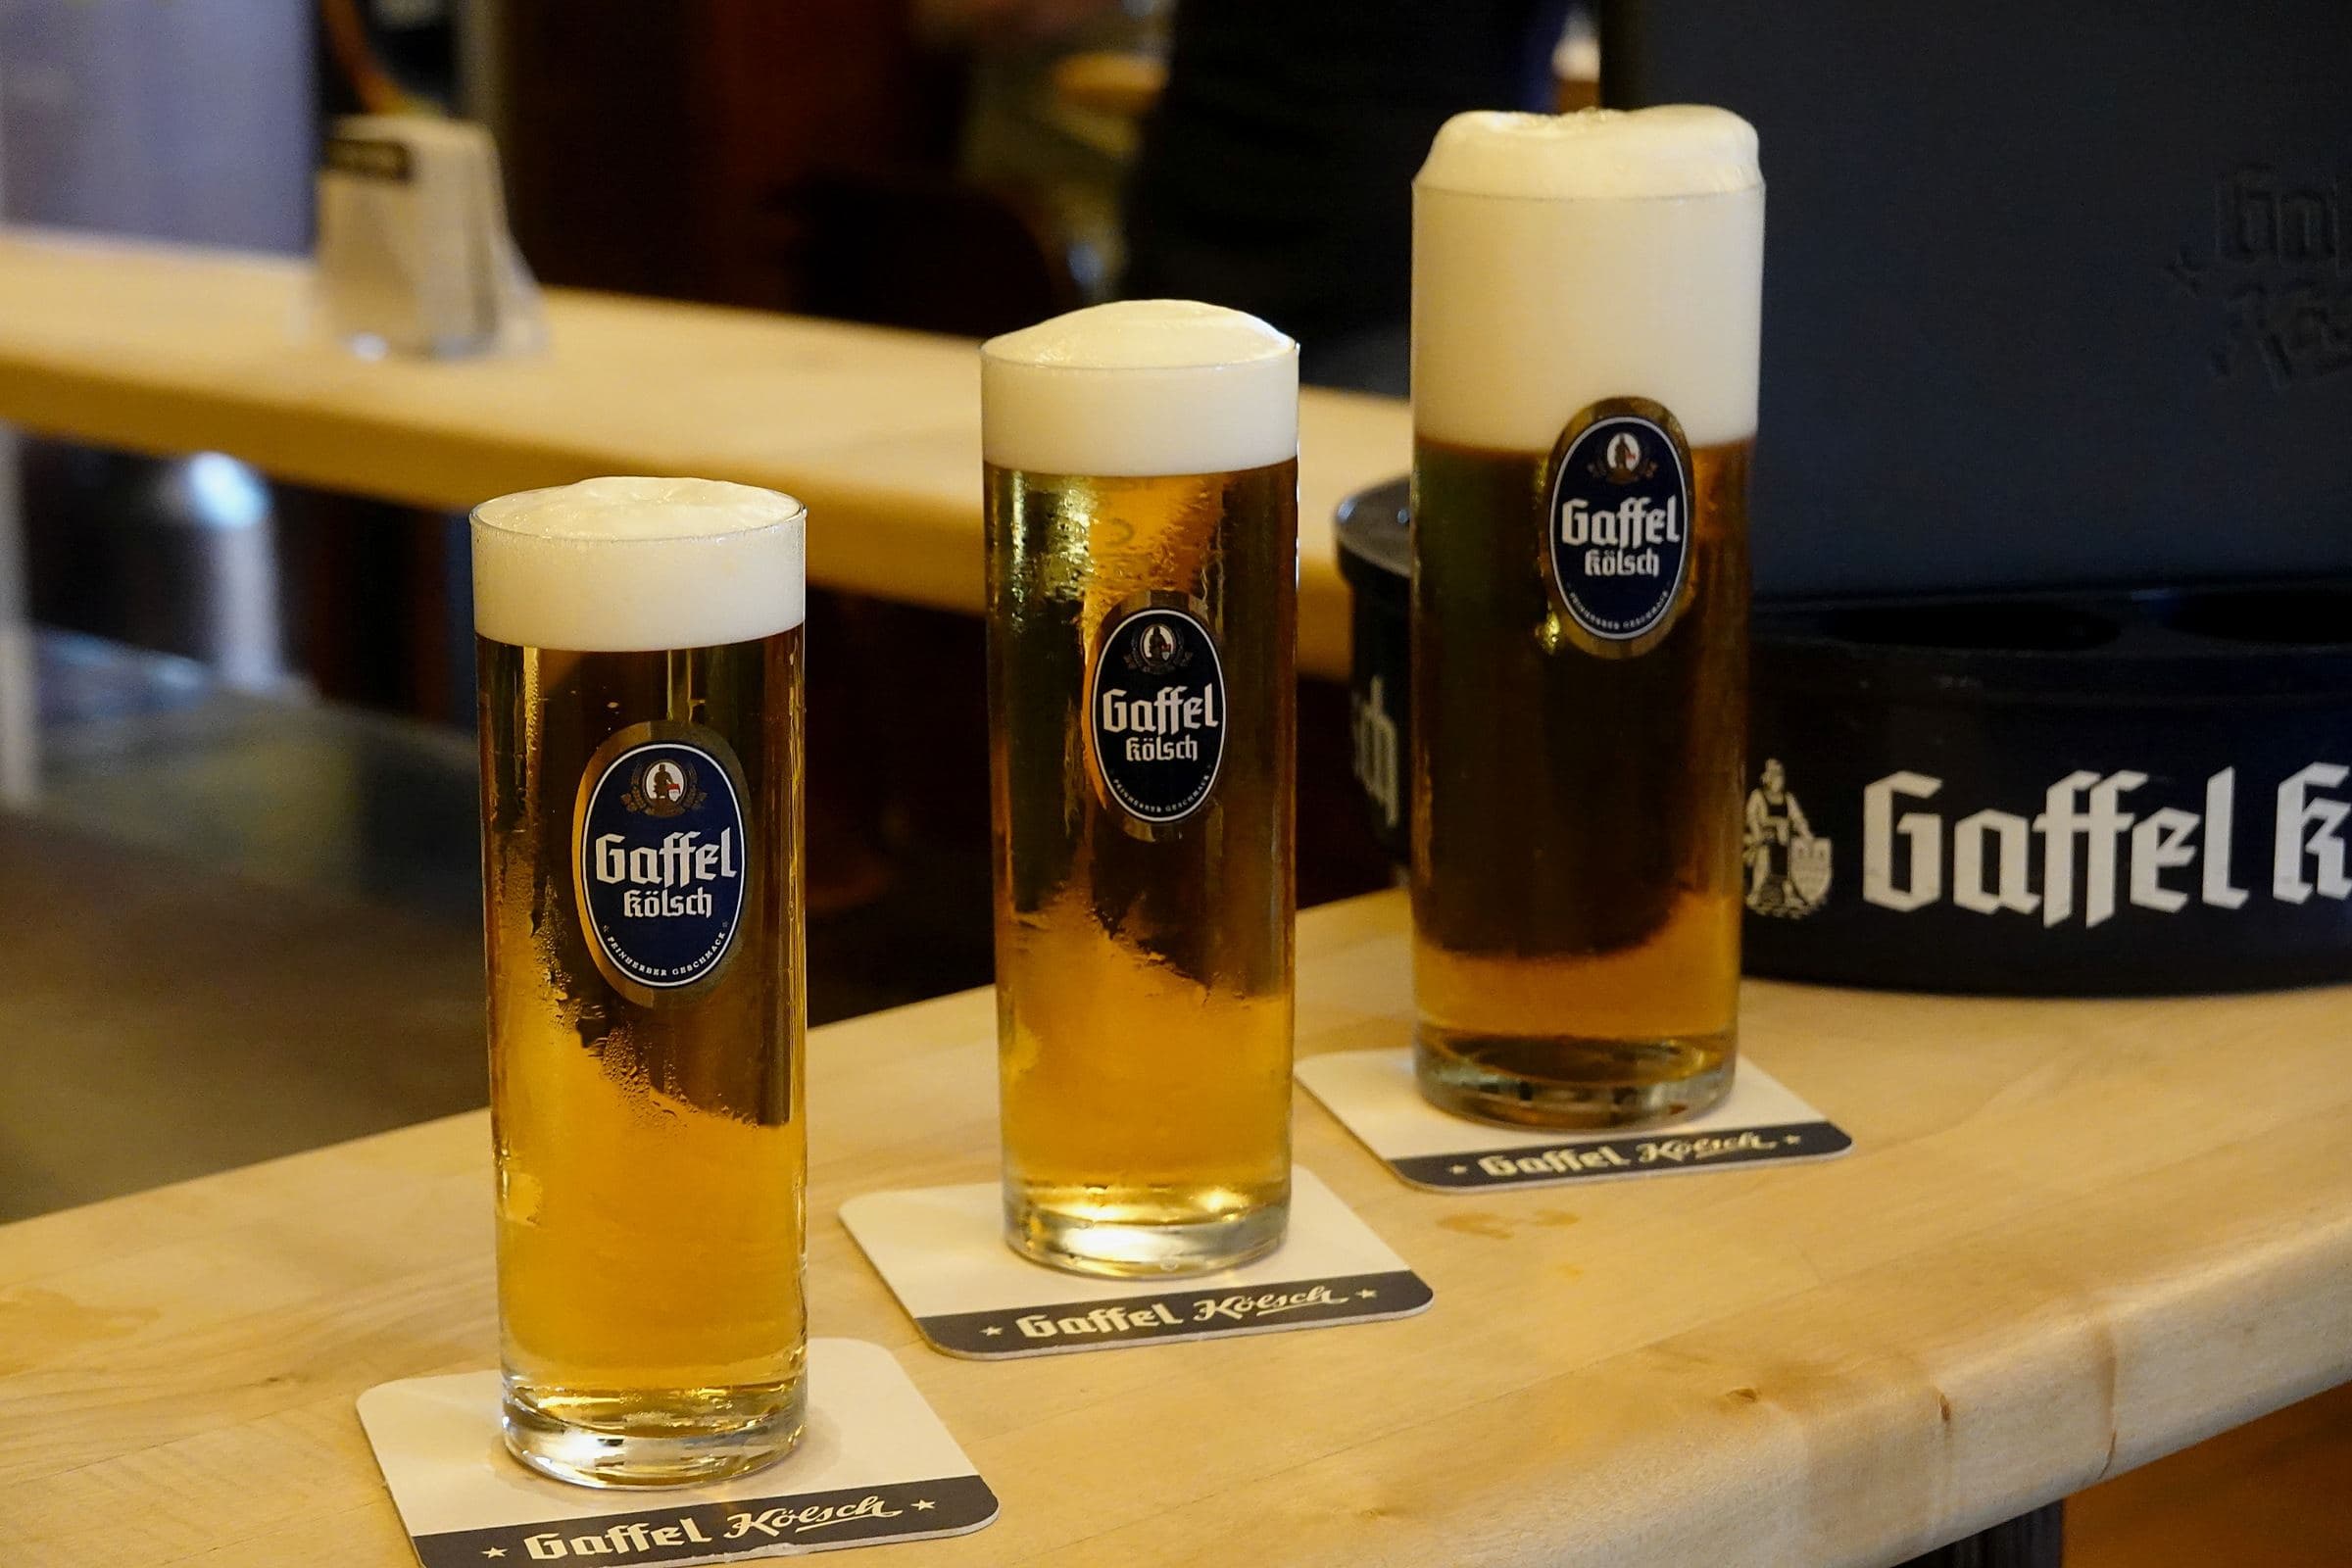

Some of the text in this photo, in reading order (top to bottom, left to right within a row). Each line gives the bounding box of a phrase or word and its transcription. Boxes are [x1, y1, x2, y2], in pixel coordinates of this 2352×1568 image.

[1562, 495, 1681, 550] Gaffel
[1585, 547, 1660, 578] Kölsch
[1102, 683, 1219, 736] Gaffel
[1125, 734, 1198, 761] Kölsch
[595, 826, 737, 888] Gaffel
[1864, 766, 2249, 928] Gaffel
[623, 886, 712, 918] Kölsch
[607, 931, 726, 977] FEINHERBER GESCHMACK
[1478, 1145, 1632, 1177] Gaffel
[1015, 1302, 1184, 1339] Gaffel
[522, 1494, 904, 1560] Gaffel Kölsch
